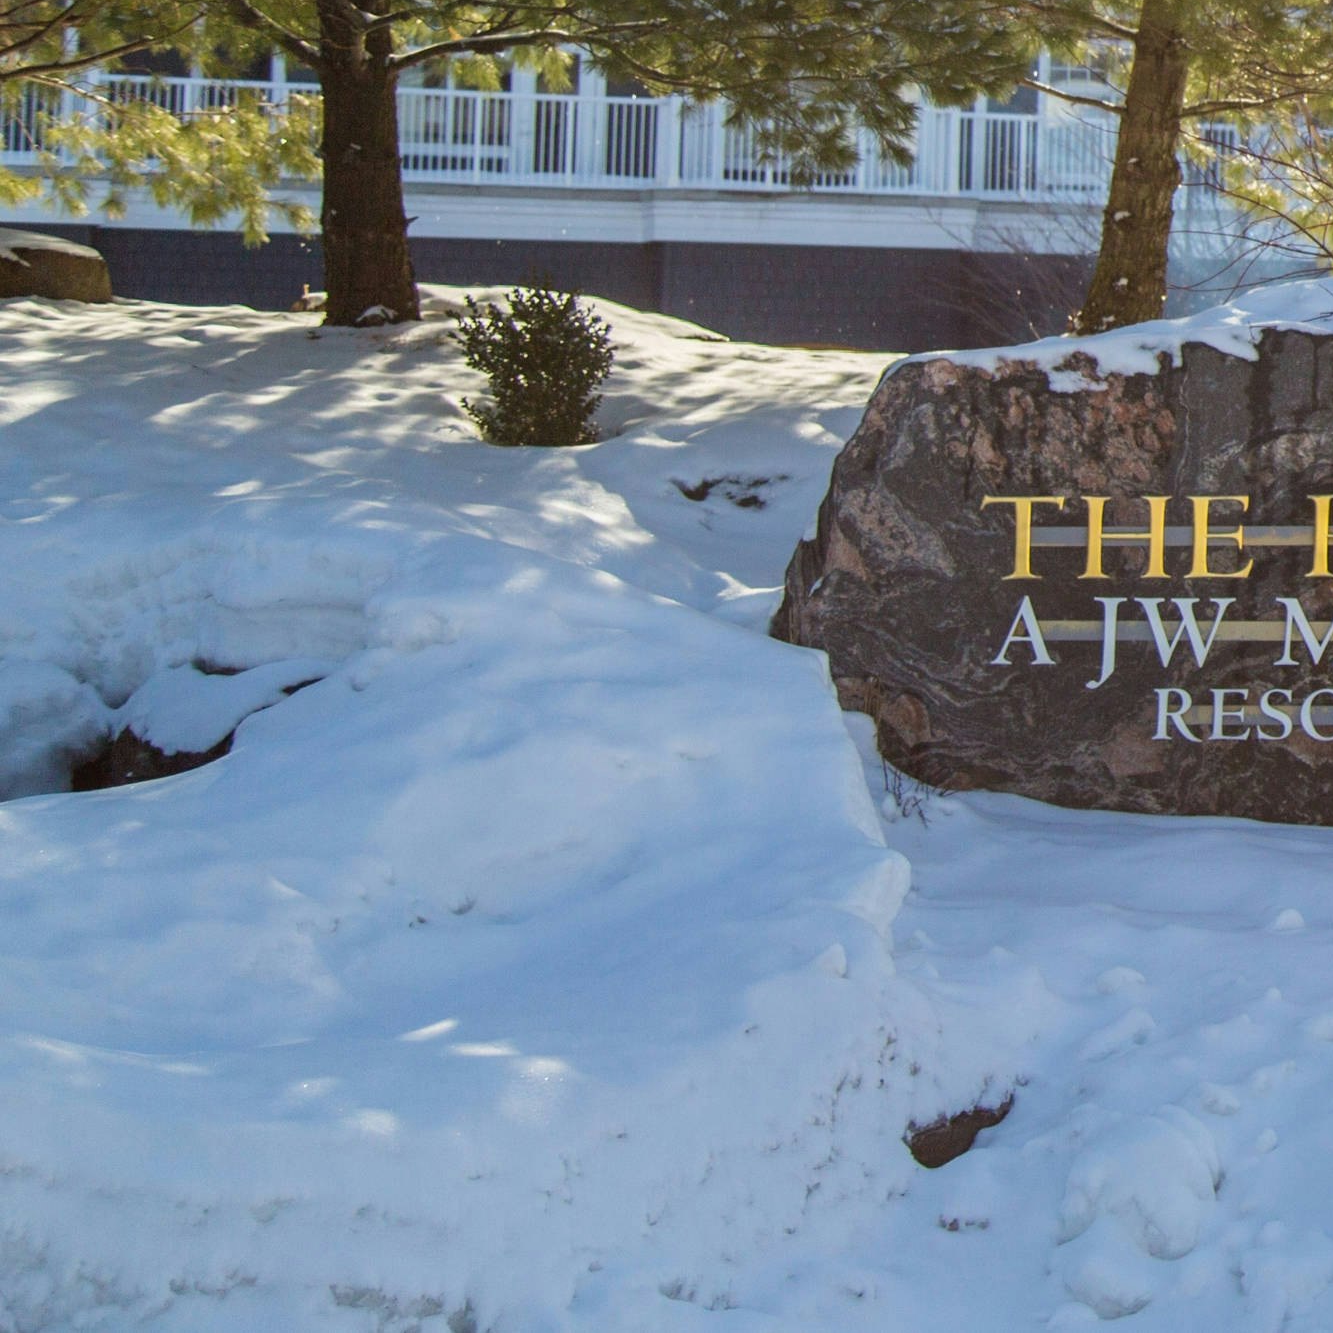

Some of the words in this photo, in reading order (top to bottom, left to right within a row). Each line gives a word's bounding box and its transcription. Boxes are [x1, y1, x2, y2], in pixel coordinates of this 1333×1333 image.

[980, 494, 1254, 581] THE
[990, 595, 1056, 665] A
[1085, 597, 1237, 689] JW
